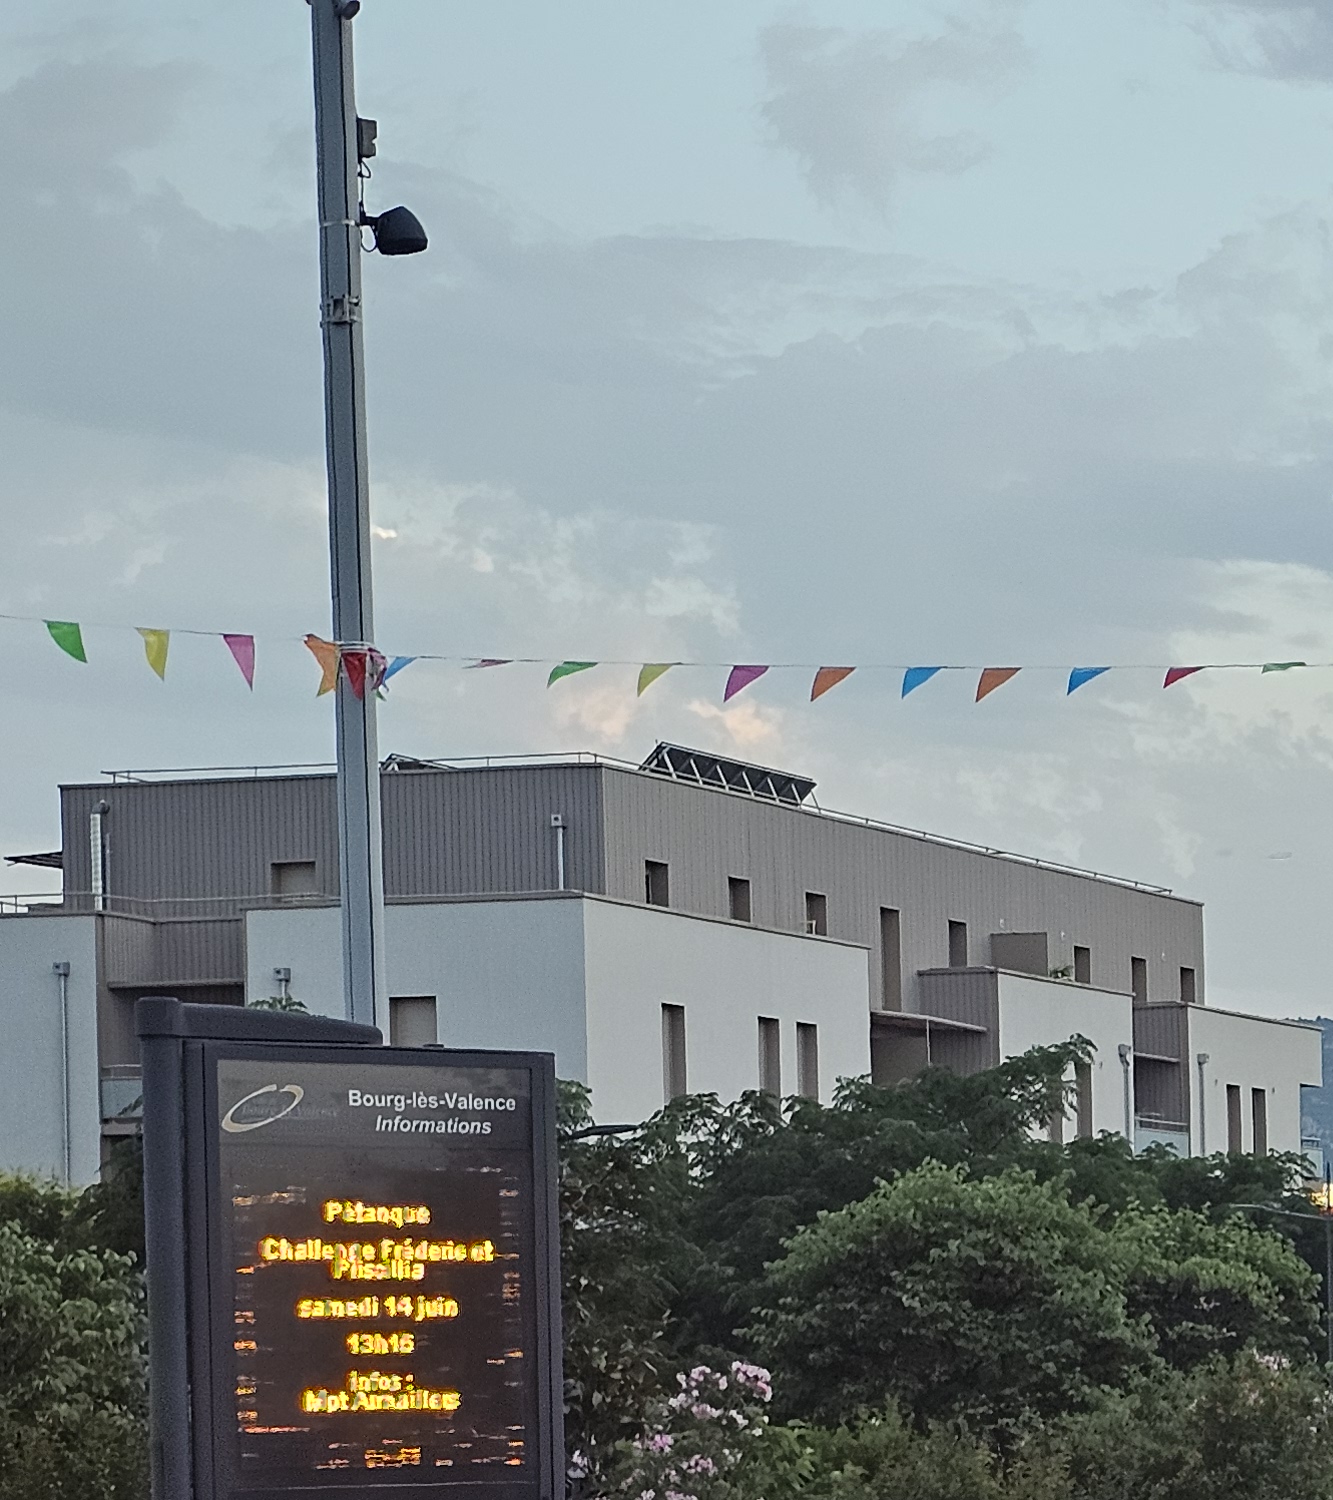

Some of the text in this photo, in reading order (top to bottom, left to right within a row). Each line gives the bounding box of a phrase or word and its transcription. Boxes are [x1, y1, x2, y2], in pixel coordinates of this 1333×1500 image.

[348, 1089, 517, 1113] Bourg-lès-Valence
[375, 1114, 493, 1135] Informations
[263, 1237, 376, 1263] Challenge
[297, 1294, 380, 1318] samedi
[415, 1294, 460, 1322] juin
